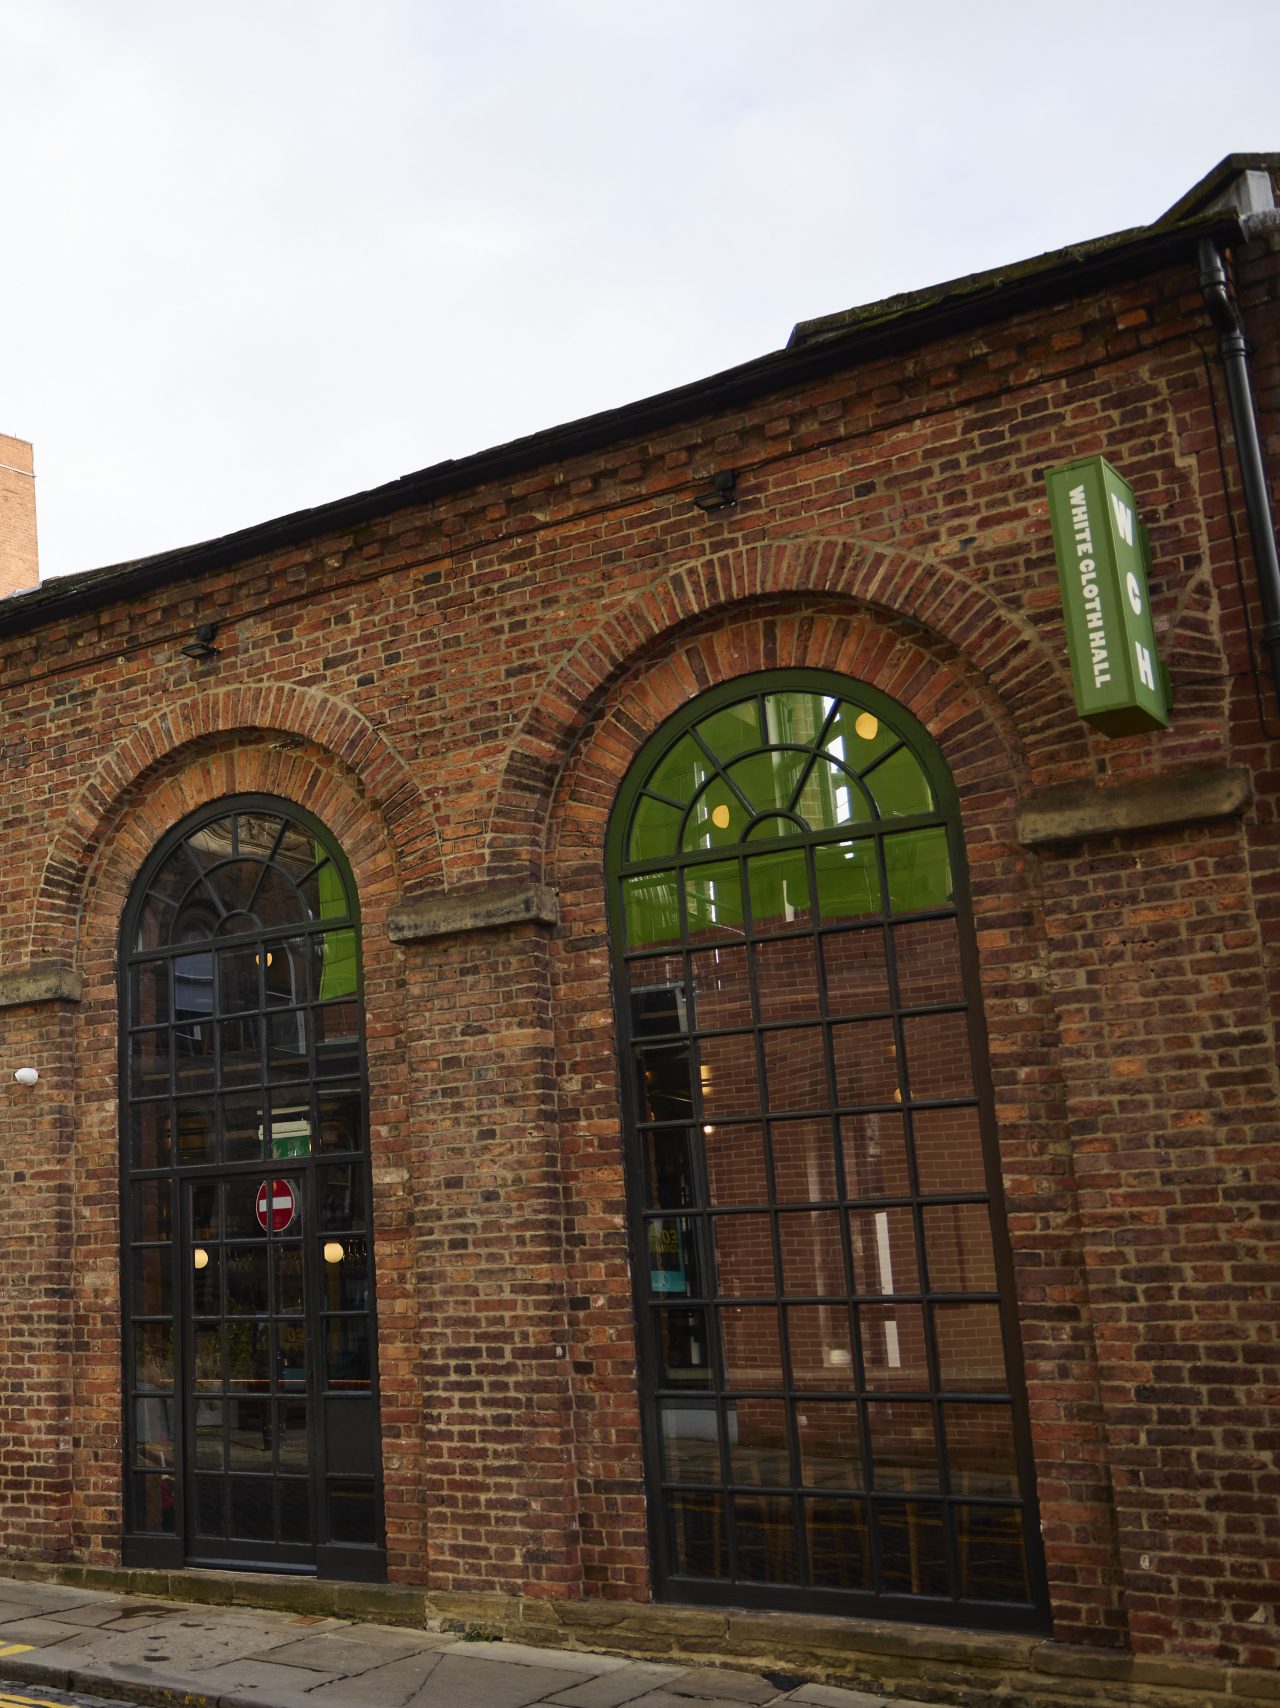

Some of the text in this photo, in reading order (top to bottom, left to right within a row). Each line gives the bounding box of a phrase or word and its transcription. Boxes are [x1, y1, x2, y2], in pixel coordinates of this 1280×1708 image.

[1068, 485, 1112, 689] WHITE CLOTH HALL
[1110, 491, 1155, 692] WCH
